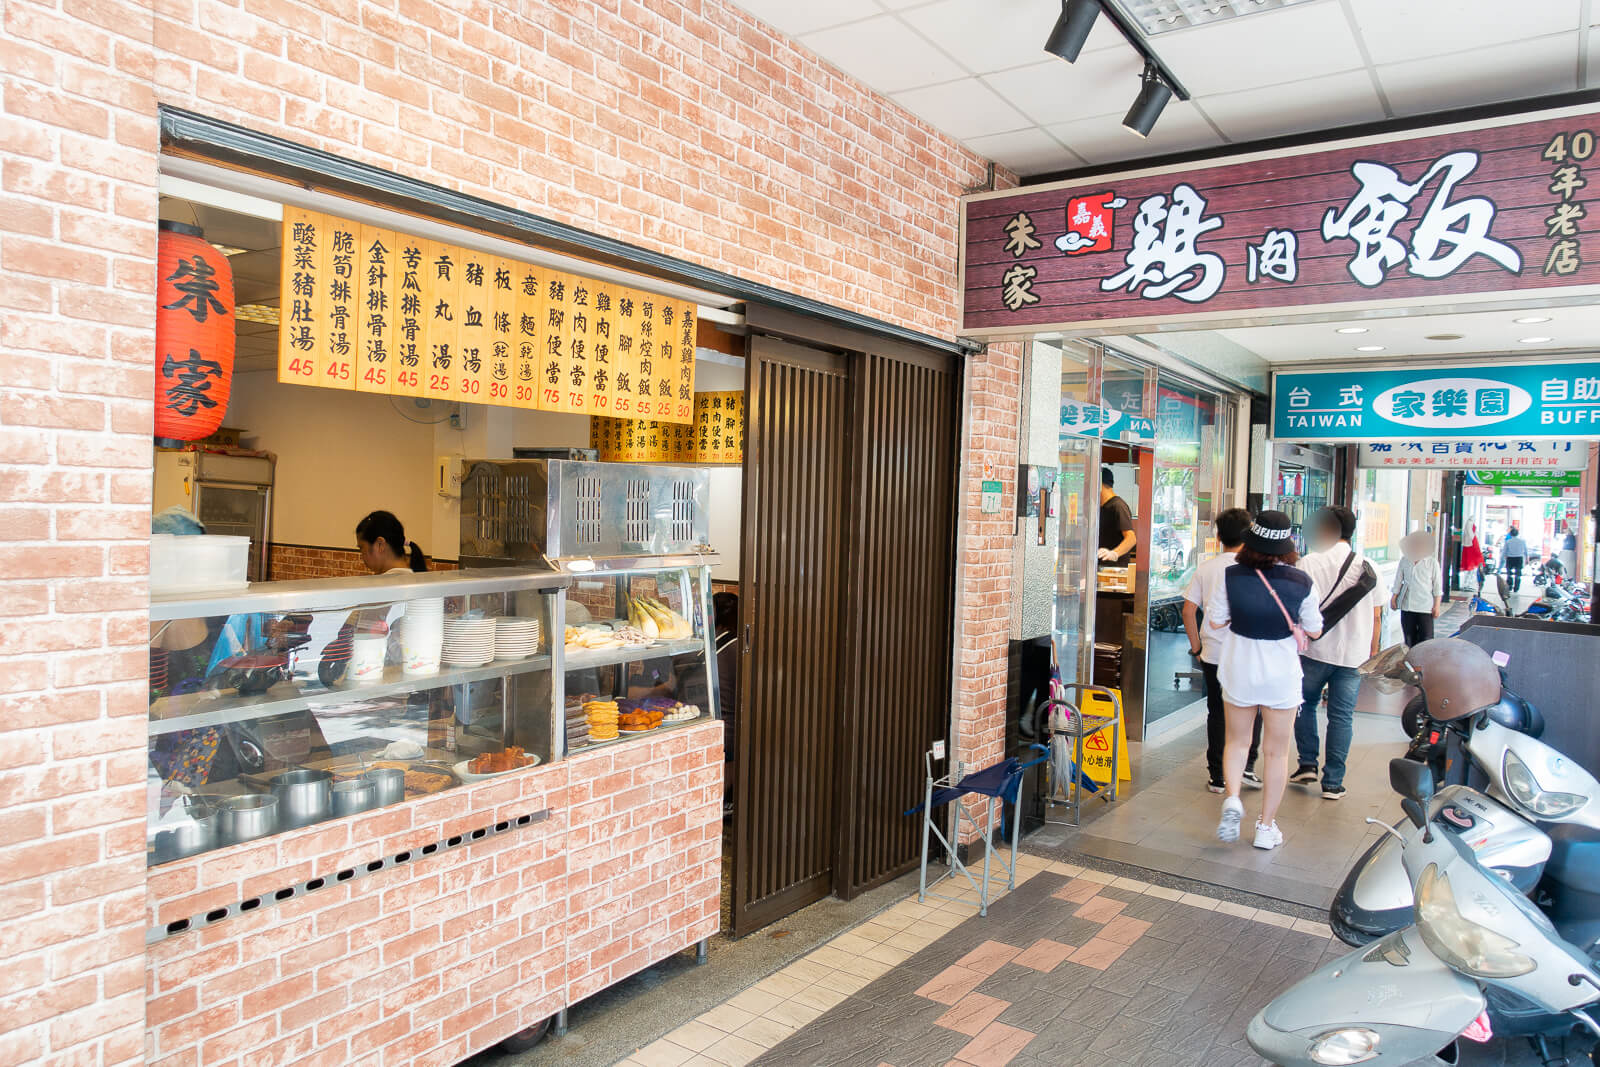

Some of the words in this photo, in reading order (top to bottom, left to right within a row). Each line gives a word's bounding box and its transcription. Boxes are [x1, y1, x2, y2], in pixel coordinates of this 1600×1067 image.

[1072, 201, 1108, 238] 嘉義
[1003, 212, 1042, 311] 朱家
[366, 239, 390, 363] 金針排骨湯
[399, 246, 422, 367] 苦瓜排骨湯
[432, 255, 454, 370] 貢丸湯
[463, 262, 485, 374] 豬血湯
[162, 254, 229, 417] 朱家
[594, 292, 611, 392] 雞肉便當
[288, 358, 314, 376] 45
[327, 361, 350, 380] 45
[364, 367, 387, 385] 45
[397, 370, 418, 387] 45
[430, 374, 449, 391] 25
[461, 378, 479, 394] 30
[489, 382, 508, 398] 30
[516, 385, 532, 401] 30
[544, 388, 560, 404] 75
[569, 391, 583, 407] 75
[593, 394, 608, 408] 70
[615, 397, 629, 411] 55
[1288, 384, 1364, 407] 台式
[1391, 388, 1510, 418] 家樂園
[637, 401, 651, 414] 55
[657, 402, 671, 415] 25
[677, 404, 689, 417] 30
[1287, 414, 1363, 429] TAIWAN
